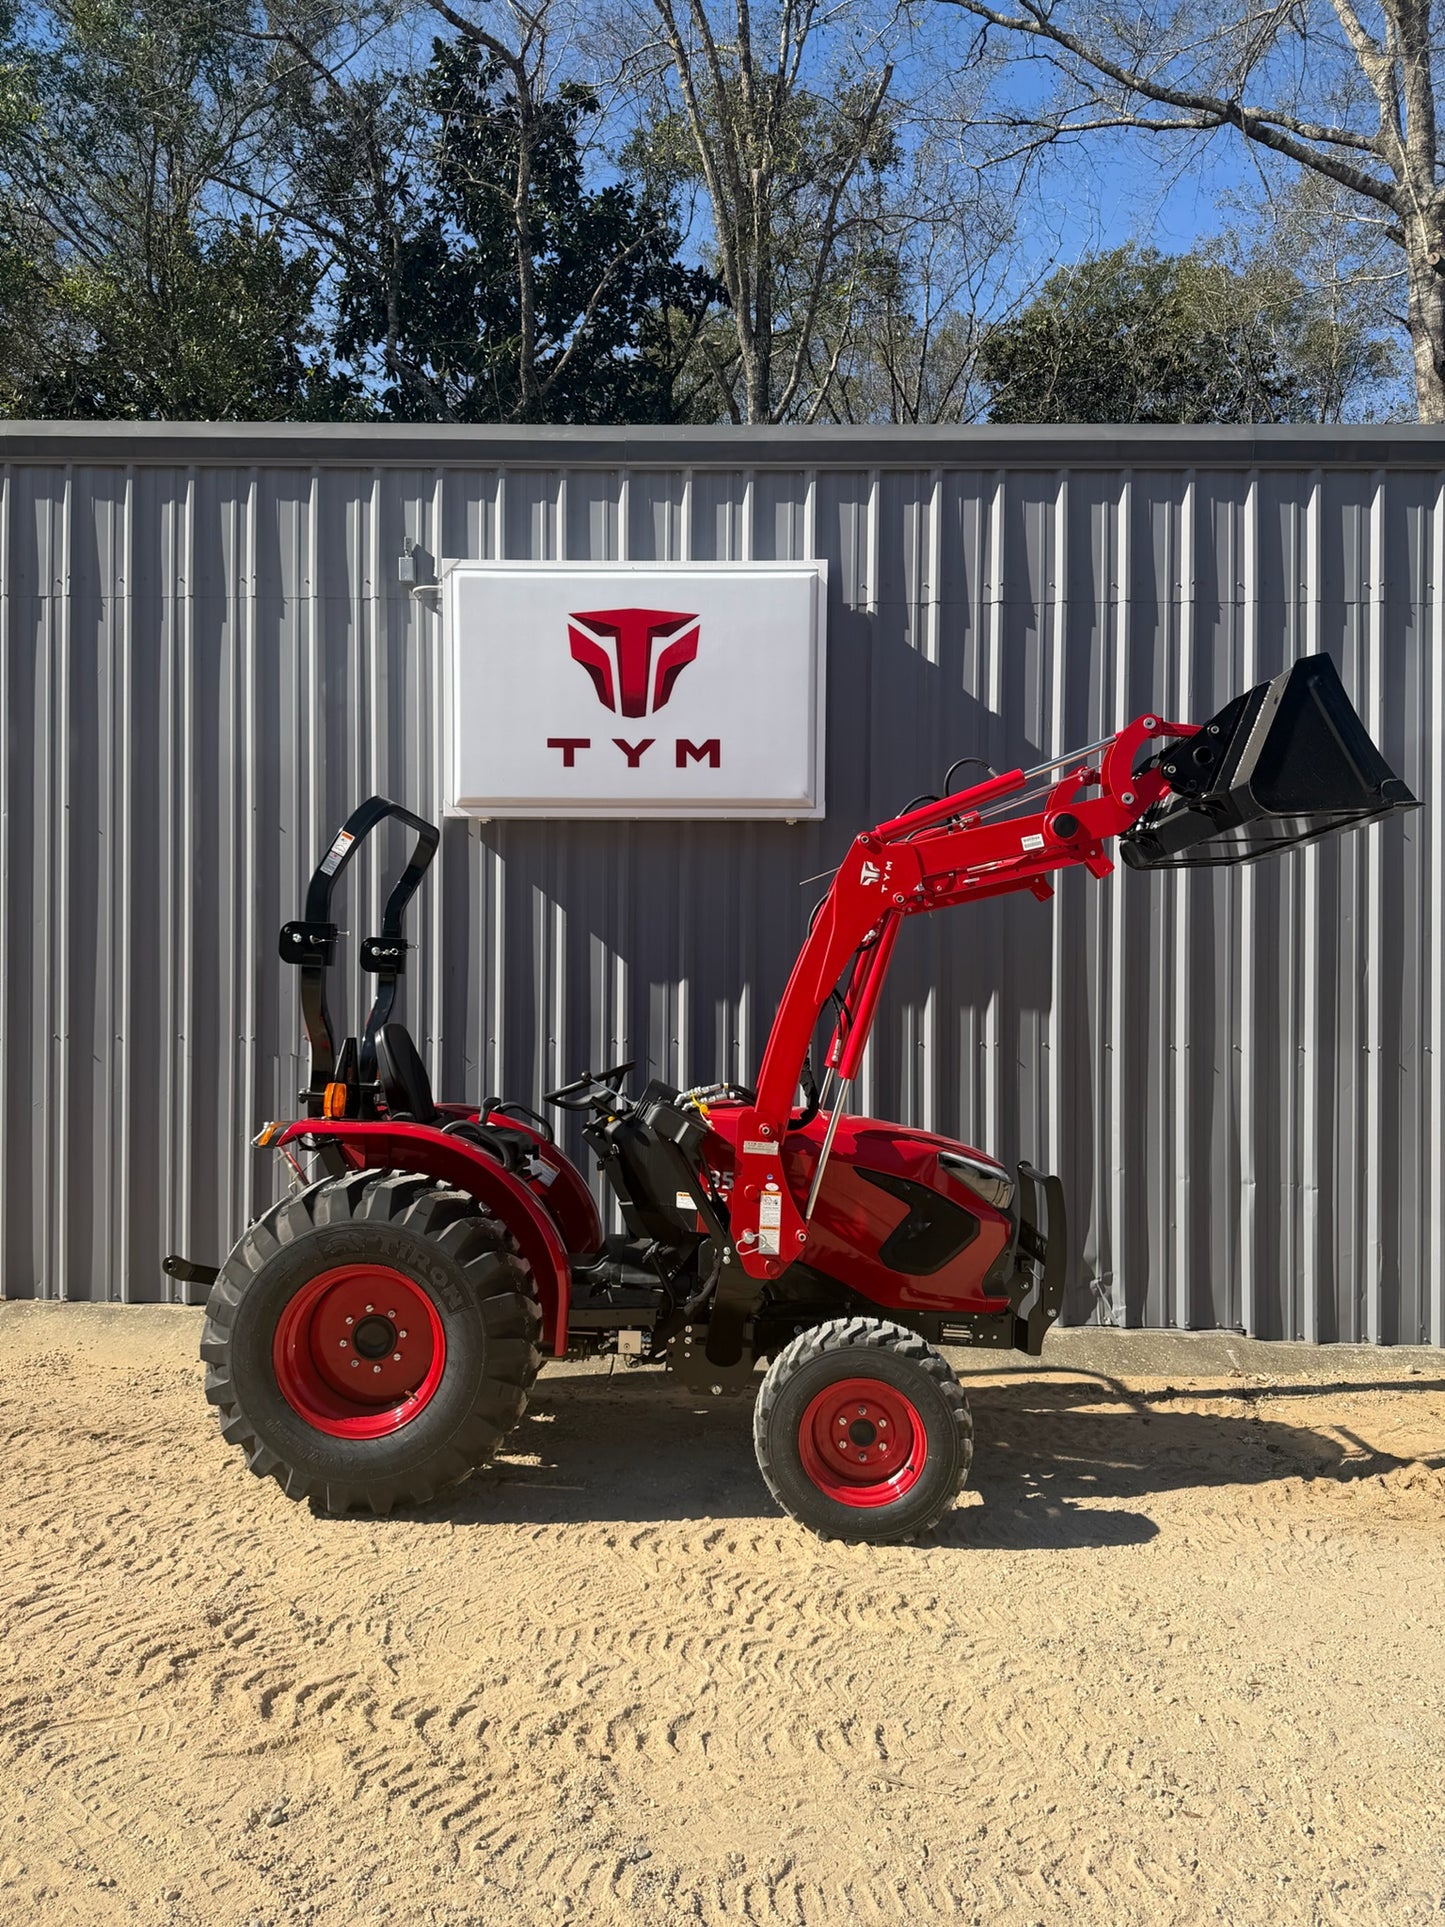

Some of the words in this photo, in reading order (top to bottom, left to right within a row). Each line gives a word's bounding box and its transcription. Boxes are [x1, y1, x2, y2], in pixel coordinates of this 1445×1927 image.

[547, 738, 721, 768] TYM
[881, 861, 893, 893] TYM
[709, 1170, 734, 1189] 35
